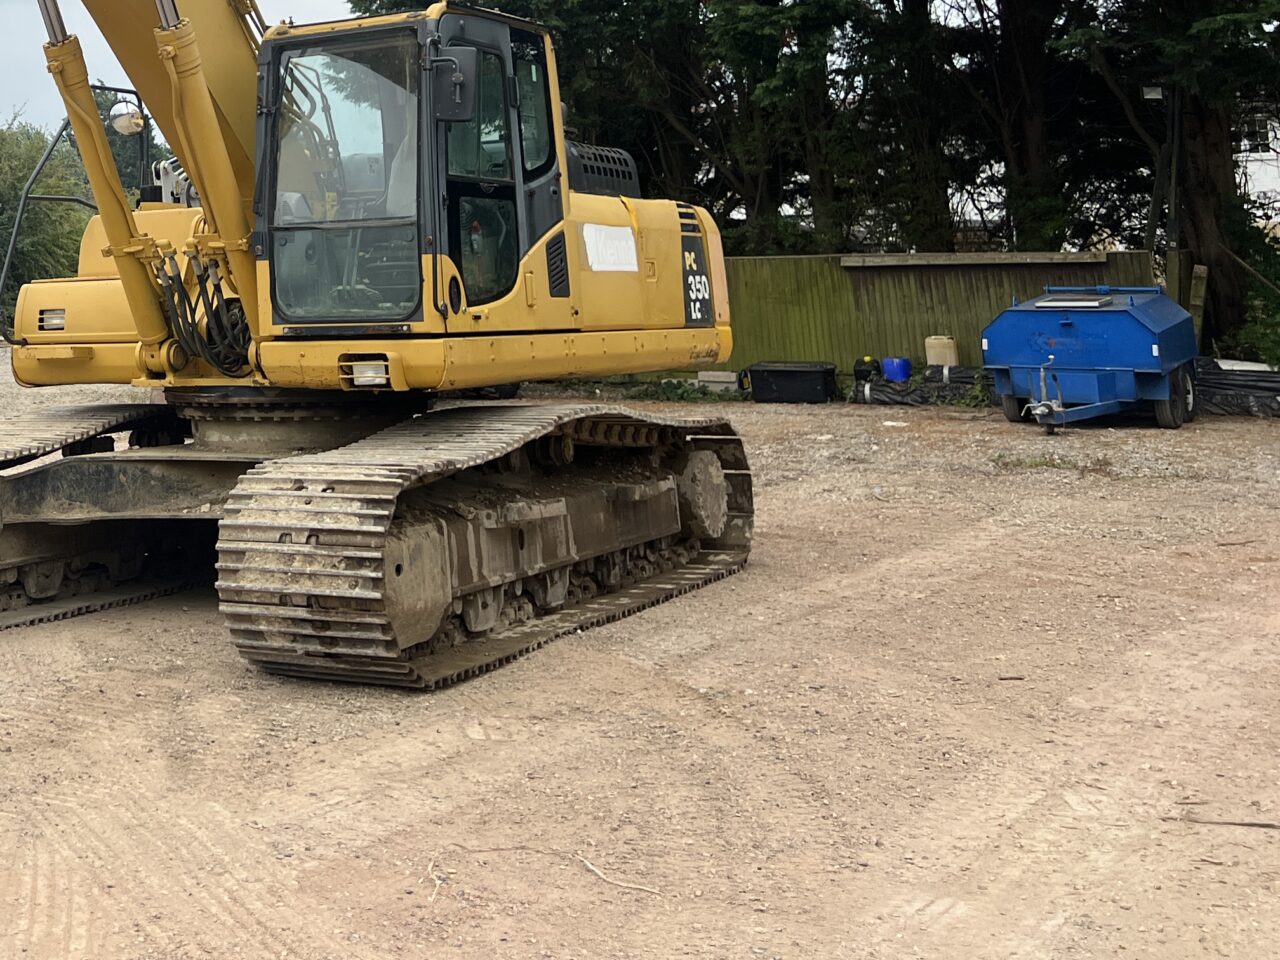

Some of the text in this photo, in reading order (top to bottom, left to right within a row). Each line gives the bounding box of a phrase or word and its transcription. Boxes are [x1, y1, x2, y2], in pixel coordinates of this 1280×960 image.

[684, 251, 697, 271] PC
[687, 275, 709, 300] 350
[690, 301, 702, 320] LC
